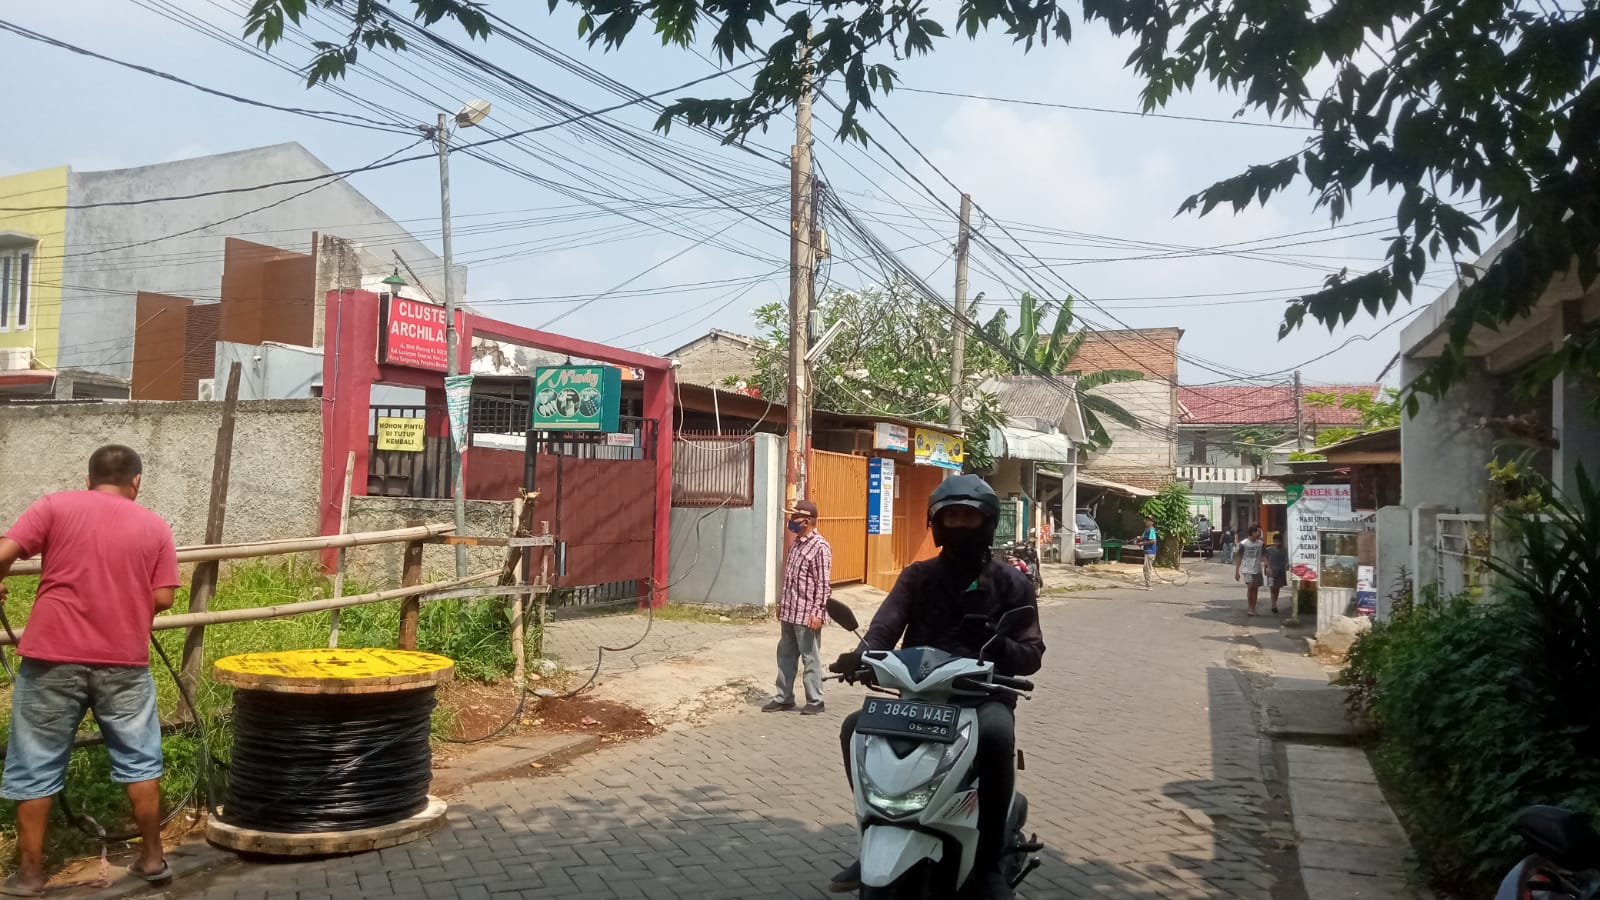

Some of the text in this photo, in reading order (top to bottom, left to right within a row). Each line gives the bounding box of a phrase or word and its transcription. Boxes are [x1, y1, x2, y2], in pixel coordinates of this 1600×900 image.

[399, 302, 447, 324] CLUSTE
[391, 320, 460, 345] ARCHILA
[868, 702, 953, 722] B 3846 WAE
